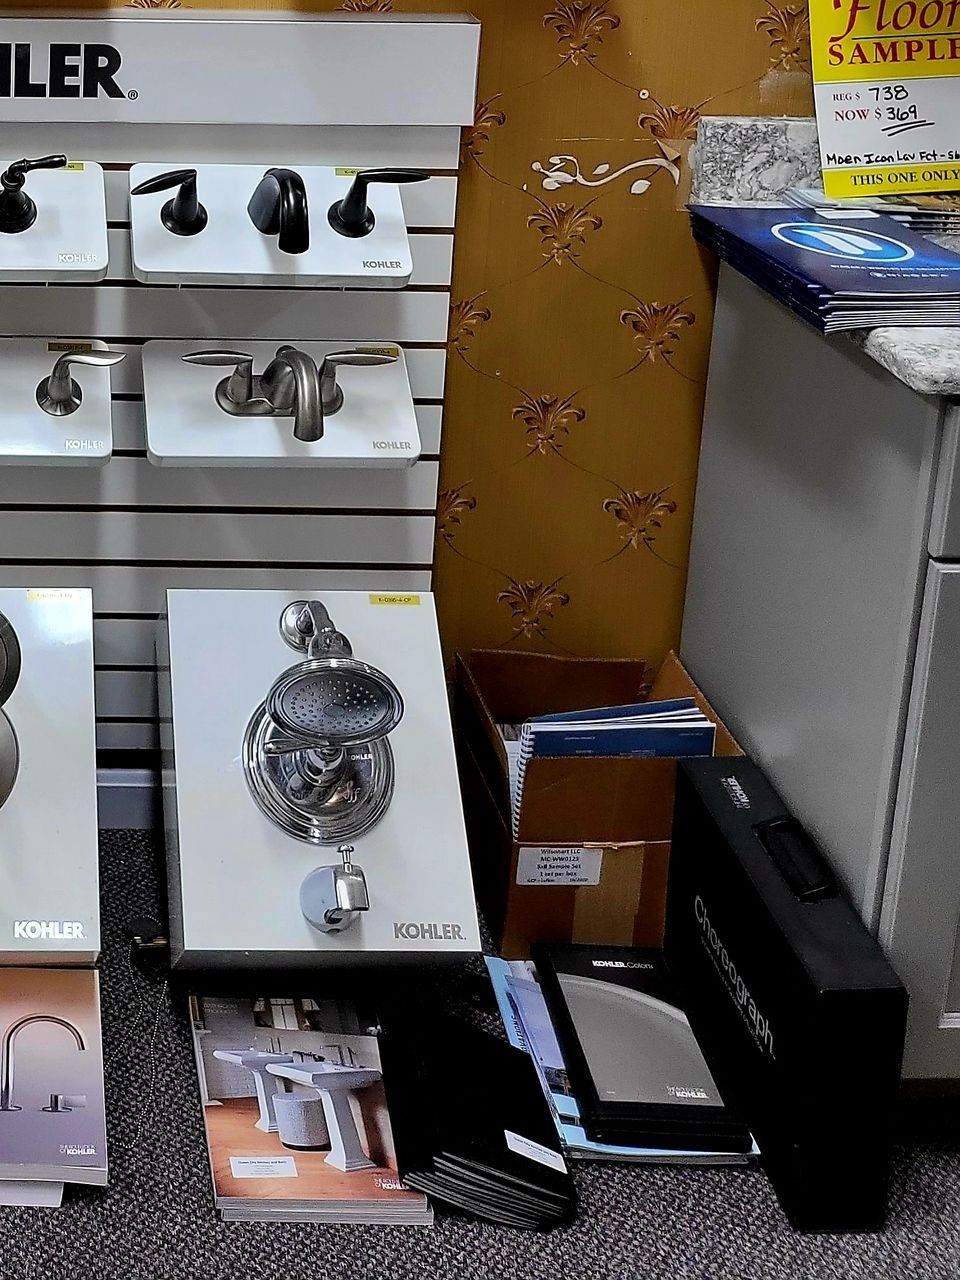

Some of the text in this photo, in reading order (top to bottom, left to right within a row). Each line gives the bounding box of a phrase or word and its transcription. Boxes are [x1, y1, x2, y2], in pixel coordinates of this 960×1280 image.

[828, 38, 960, 66] SAMPLE
[832, 84, 909, 101] REG $ 738
[834, 104, 918, 121] NOW $ 369
[826, 152, 861, 165] Moen
[863, 152, 895, 165] Icon
[850, 169, 960, 186] THIS ONE ONLY
[58, 254, 97, 262] KOHLER
[362, 261, 402, 269] KOHLER
[65, 440, 104, 449] KOHLER
[372, 441, 412, 450] KOHLER
[695, 894, 774, 1054] Choreograph
[675, 1091, 709, 1099] KOHLER
